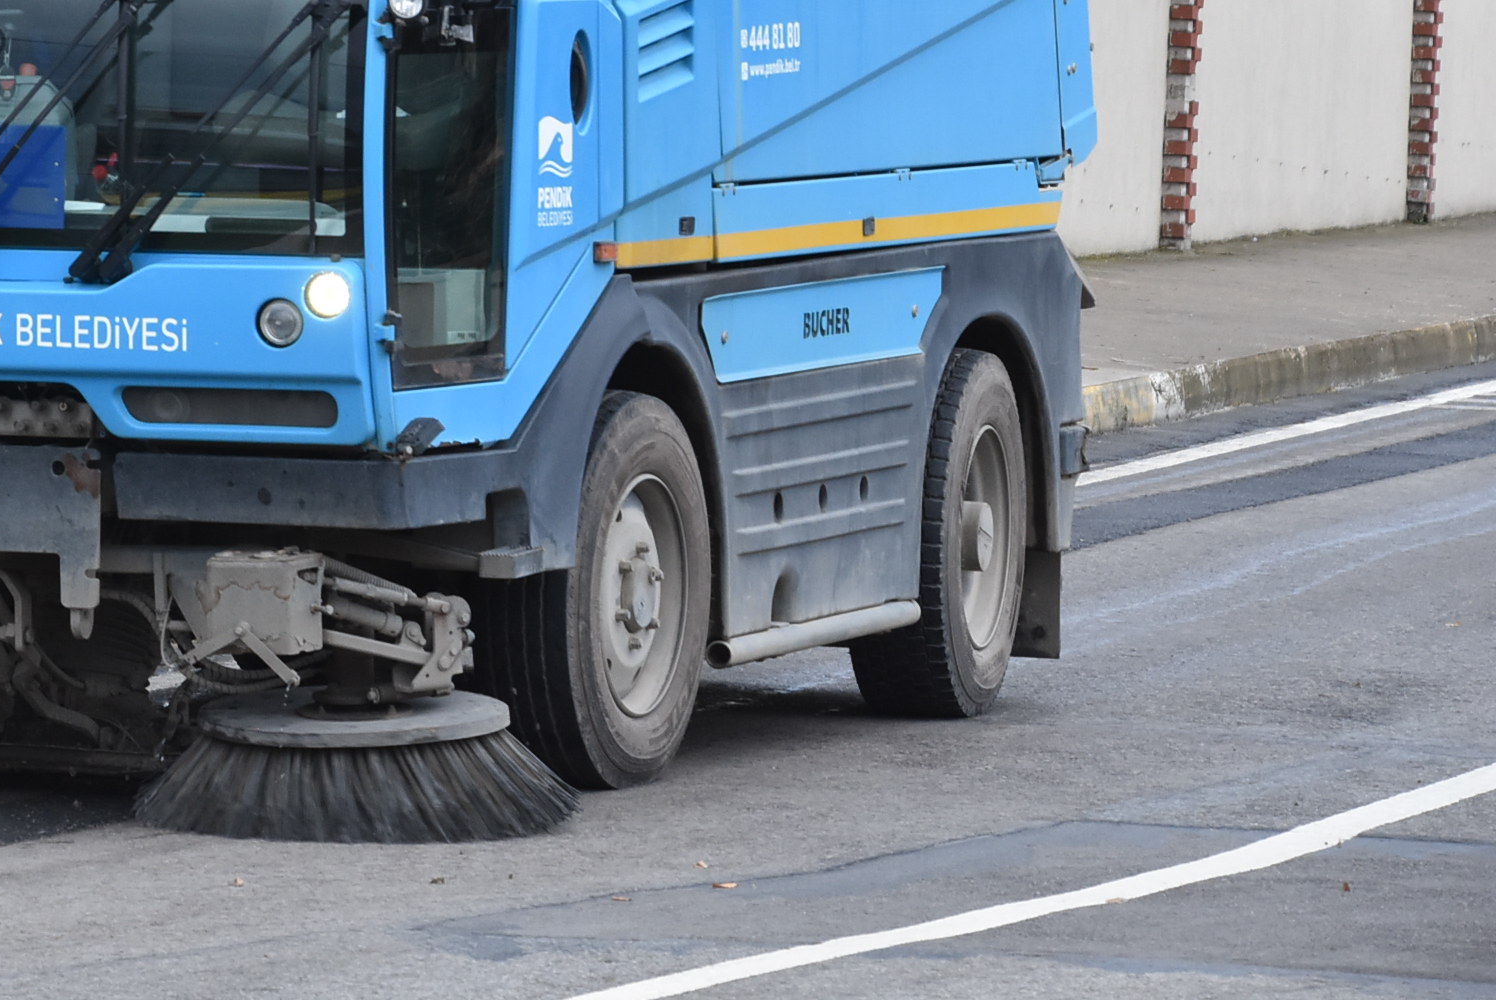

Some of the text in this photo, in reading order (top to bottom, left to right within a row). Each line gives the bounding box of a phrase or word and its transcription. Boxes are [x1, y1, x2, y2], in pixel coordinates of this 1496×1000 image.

[749, 21, 800, 52] 444 81 80
[803, 307, 850, 339] BUCHER
